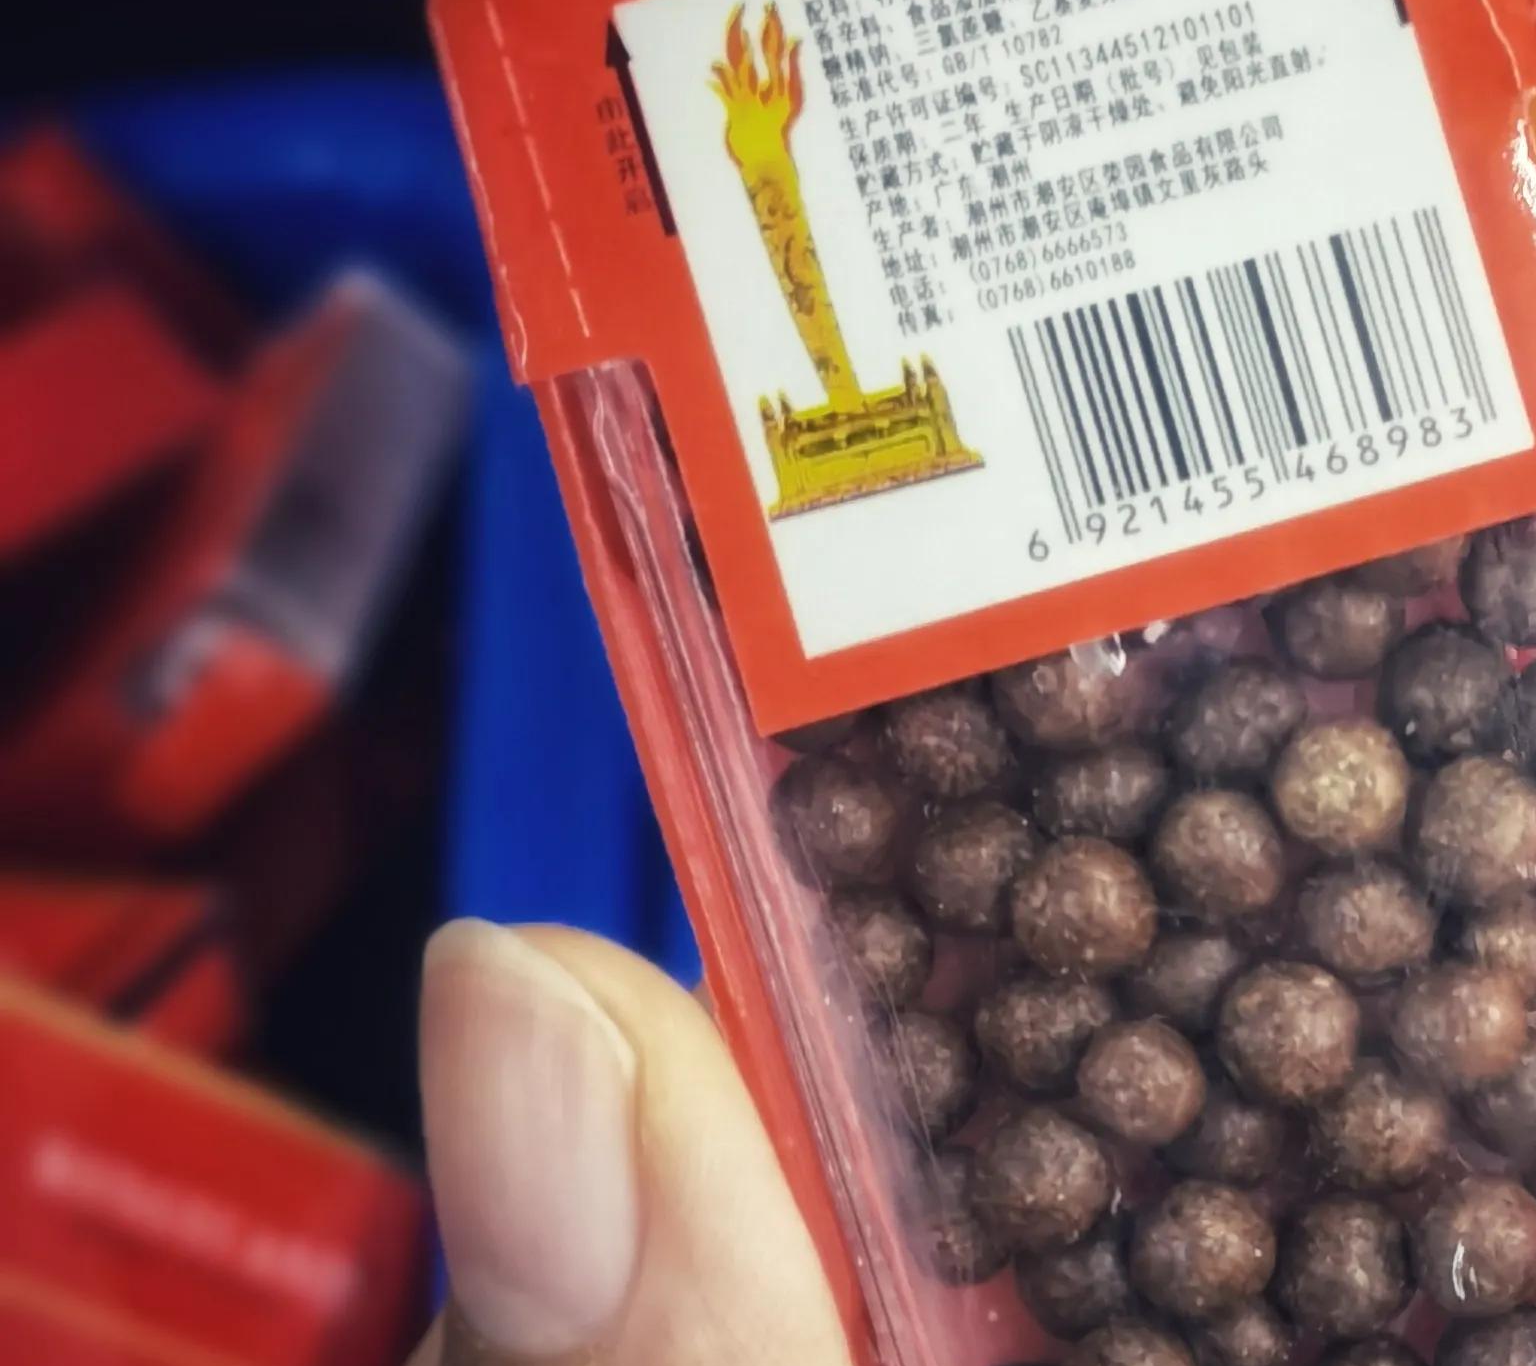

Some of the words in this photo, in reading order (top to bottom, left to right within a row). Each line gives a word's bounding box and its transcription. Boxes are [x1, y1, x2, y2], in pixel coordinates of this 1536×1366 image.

[1001, 23, 1063, 58] 10782
[1085, 466, 1266, 544] 921455
[1294, 406, 1475, 483] 468983
